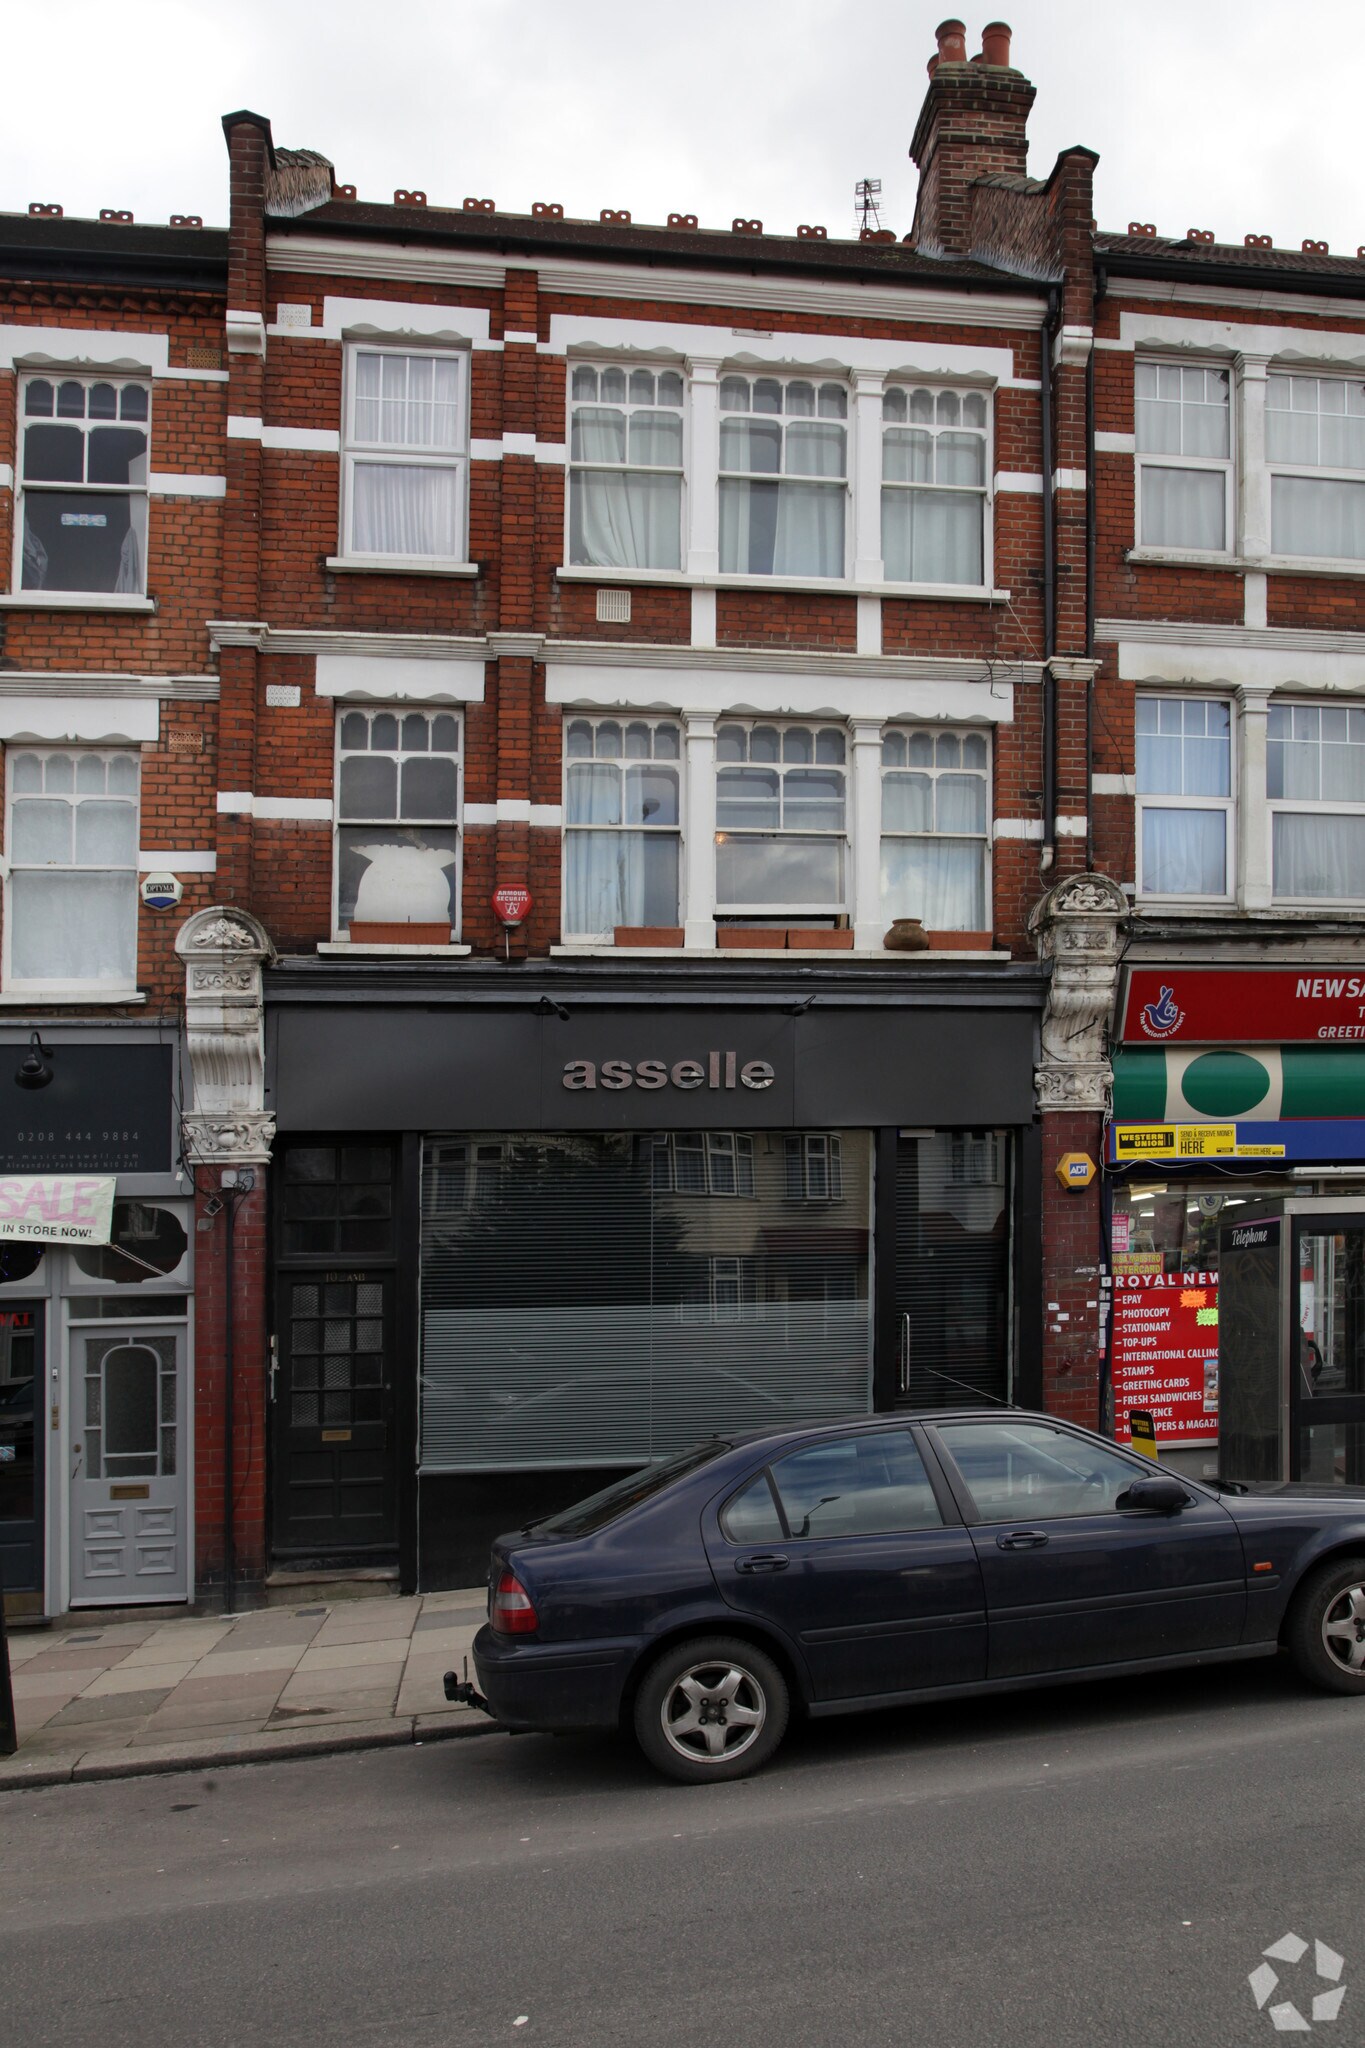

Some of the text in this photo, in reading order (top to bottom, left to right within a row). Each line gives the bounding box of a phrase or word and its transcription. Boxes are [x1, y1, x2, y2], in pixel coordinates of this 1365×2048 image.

[147, 883, 174, 893] OPTYMA
[1142, 1024, 1169, 1038] National
[1168, 1011, 1186, 1035] Lottery
[562, 1051, 776, 1090] asselle
[18, 1132, 139, 1141] 0208 444 9884
[1120, 1133, 1164, 1141] WESTERN
[1180, 1141, 1205, 1154] HERE
[1070, 1163, 1087, 1174] ADT
[0, 1182, 99, 1225] SALE
[3, 1225, 92, 1238] IN STORE NOW!
[1231, 1228, 1268, 1248] Telephone
[1115, 1273, 1176, 1288] ROYAL
[1122, 1294, 1142, 1304] EPAY
[1122, 1307, 1170, 1318] PHOTOCOPY
[1122, 1322, 1171, 1333] STATIONARY
[1122, 1337, 1157, 1347] TOP-UPS
[1122, 1350, 1186, 1361] INTERNATIONAL
[1122, 1366, 1155, 1377] STAMPS
[1122, 1378, 1190, 1390] GREETING CARDS
[1122, 1391, 1202, 1405] FRESH SANDWICHES
[1178, 1420, 1185, 1428] &
[1186, 1418, 1219, 1429] MAGAZI
